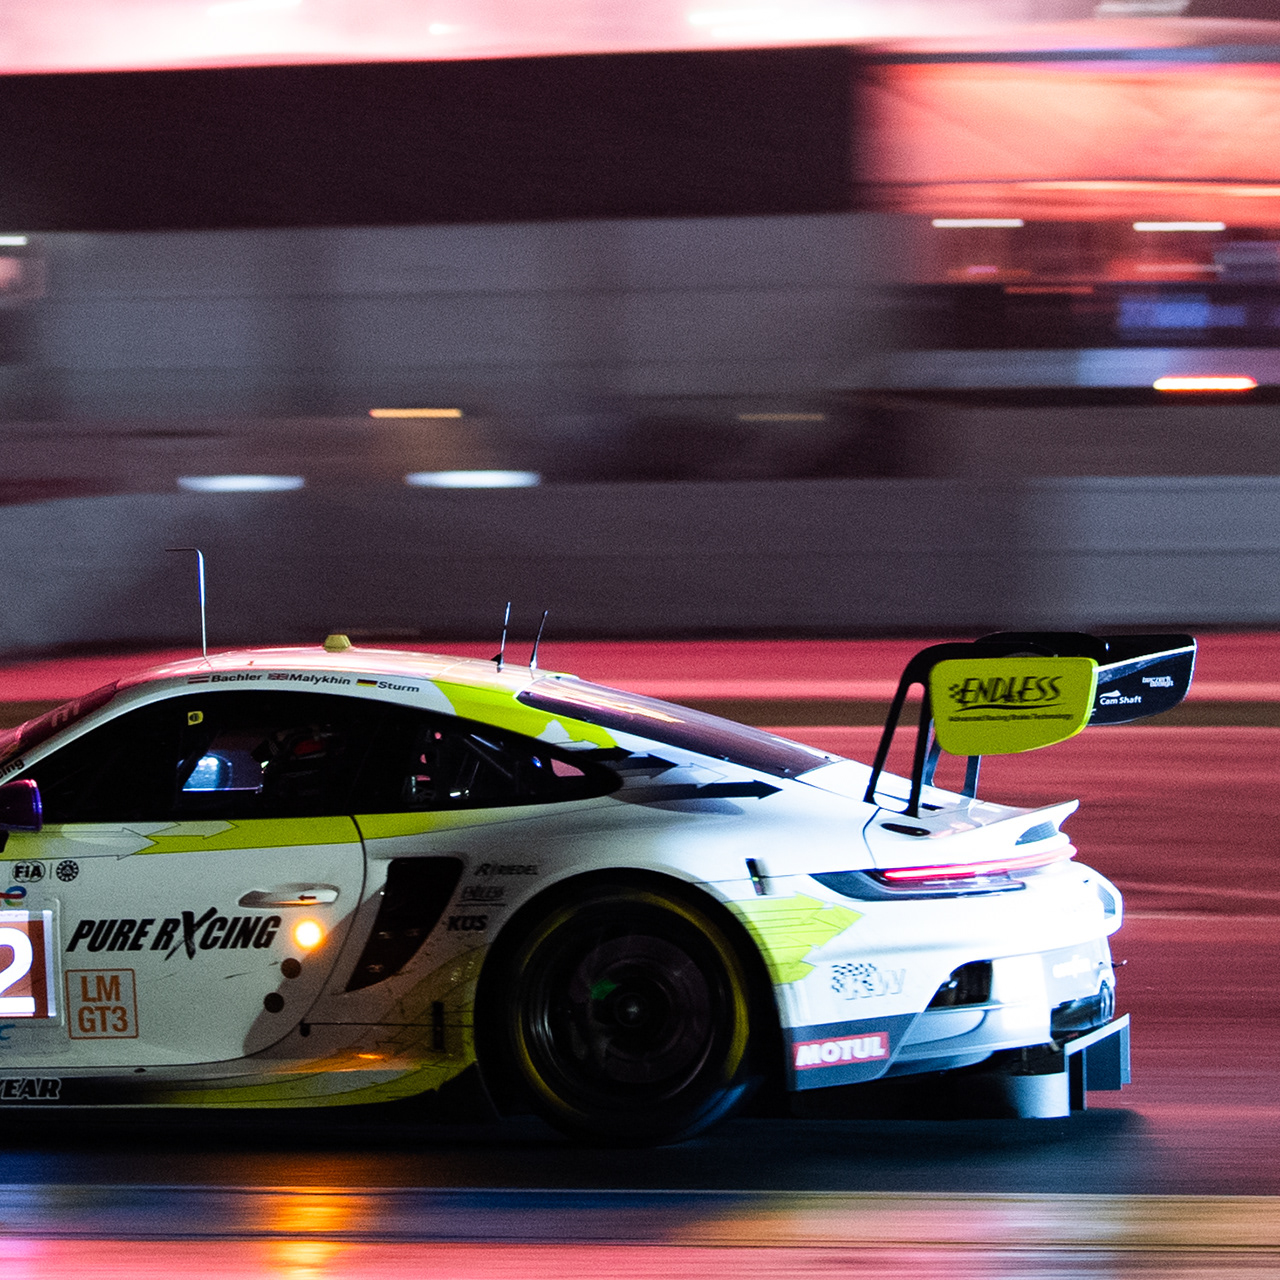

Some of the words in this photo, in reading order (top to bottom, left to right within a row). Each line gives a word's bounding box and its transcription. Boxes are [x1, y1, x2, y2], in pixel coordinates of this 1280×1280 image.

[211, 673, 263, 683] Bachler
[289, 673, 351, 686] Malykhin
[377, 681, 420, 693] Sturm
[956, 675, 1063, 704] ENDLESS
[1099, 697, 1118, 706] Cam
[1119, 695, 1142, 704] Shaft
[14, 862, 43, 879] FIA
[65, 918, 157, 953] PURE
[149, 906, 282, 961] RXCING
[80, 974, 121, 1003] LM
[77, 1005, 129, 1034] GT3
[795, 1036, 886, 1067] MOTUL
